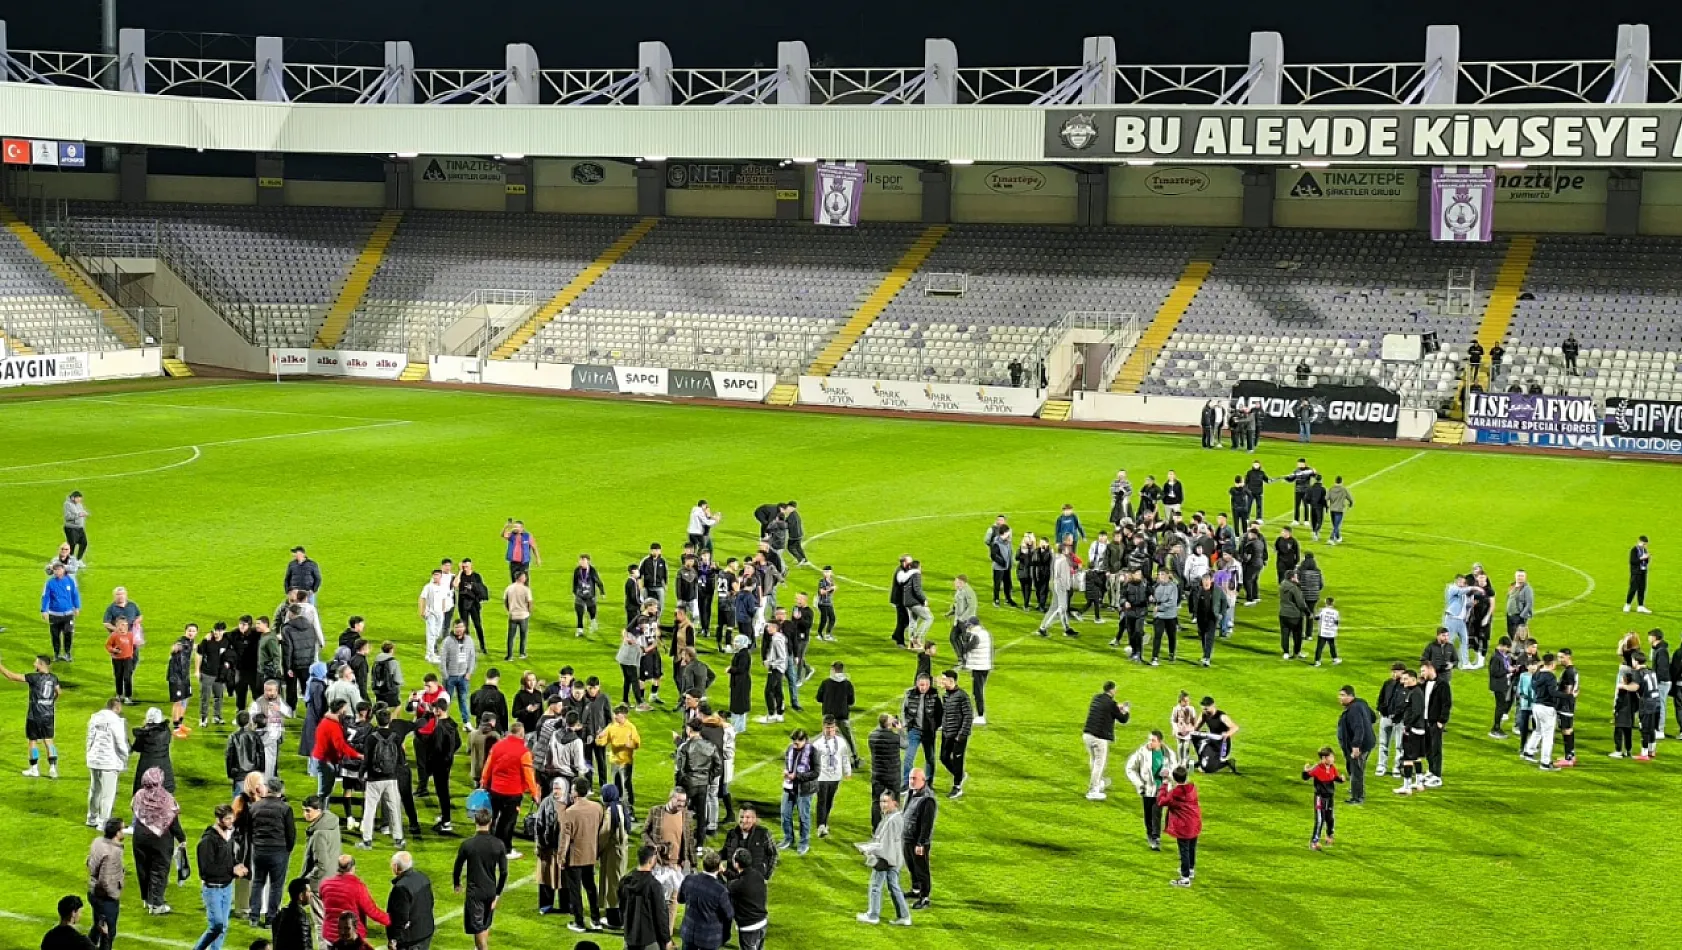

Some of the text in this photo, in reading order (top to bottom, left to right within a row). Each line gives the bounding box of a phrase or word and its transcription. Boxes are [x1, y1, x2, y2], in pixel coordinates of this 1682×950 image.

[1114, 116, 1182, 154] BU
[1193, 116, 1398, 156] ALEMDE
[1413, 114, 1658, 157] KİMSEYE
[688, 164, 735, 182] NET
[875, 174, 903, 190] spor
[1323, 172, 1405, 186] TINAZTEPE
[1495, 168, 1585, 194] naztepe
[1371, 188, 1401, 196] GRUBU
[1509, 191, 1550, 199] yumurta
[280, 355, 306, 363] alko
[317, 357, 338, 365] alko
[346, 359, 368, 367] alko
[375, 360, 398, 368] alko
[577, 370, 615, 384] VitrA
[674, 375, 712, 390] VitrA
[825, 387, 849, 395] PARK
[879, 390, 900, 398] PARK
[827, 396, 854, 404] AFYON
[931, 392, 952, 401] PARK
[983, 395, 1005, 405] PARK
[880, 399, 908, 407] AFYON
[932, 401, 959, 410] AFYON
[984, 405, 1013, 413] AFYON
[1236, 396, 1399, 423] AFYOK GRUBU
[1531, 398, 1597, 422] AFYOK
[1521, 420, 1559, 431] SPECIAL
[1561, 423, 1596, 434] FORCES
[1644, 672, 1658, 691] 11
